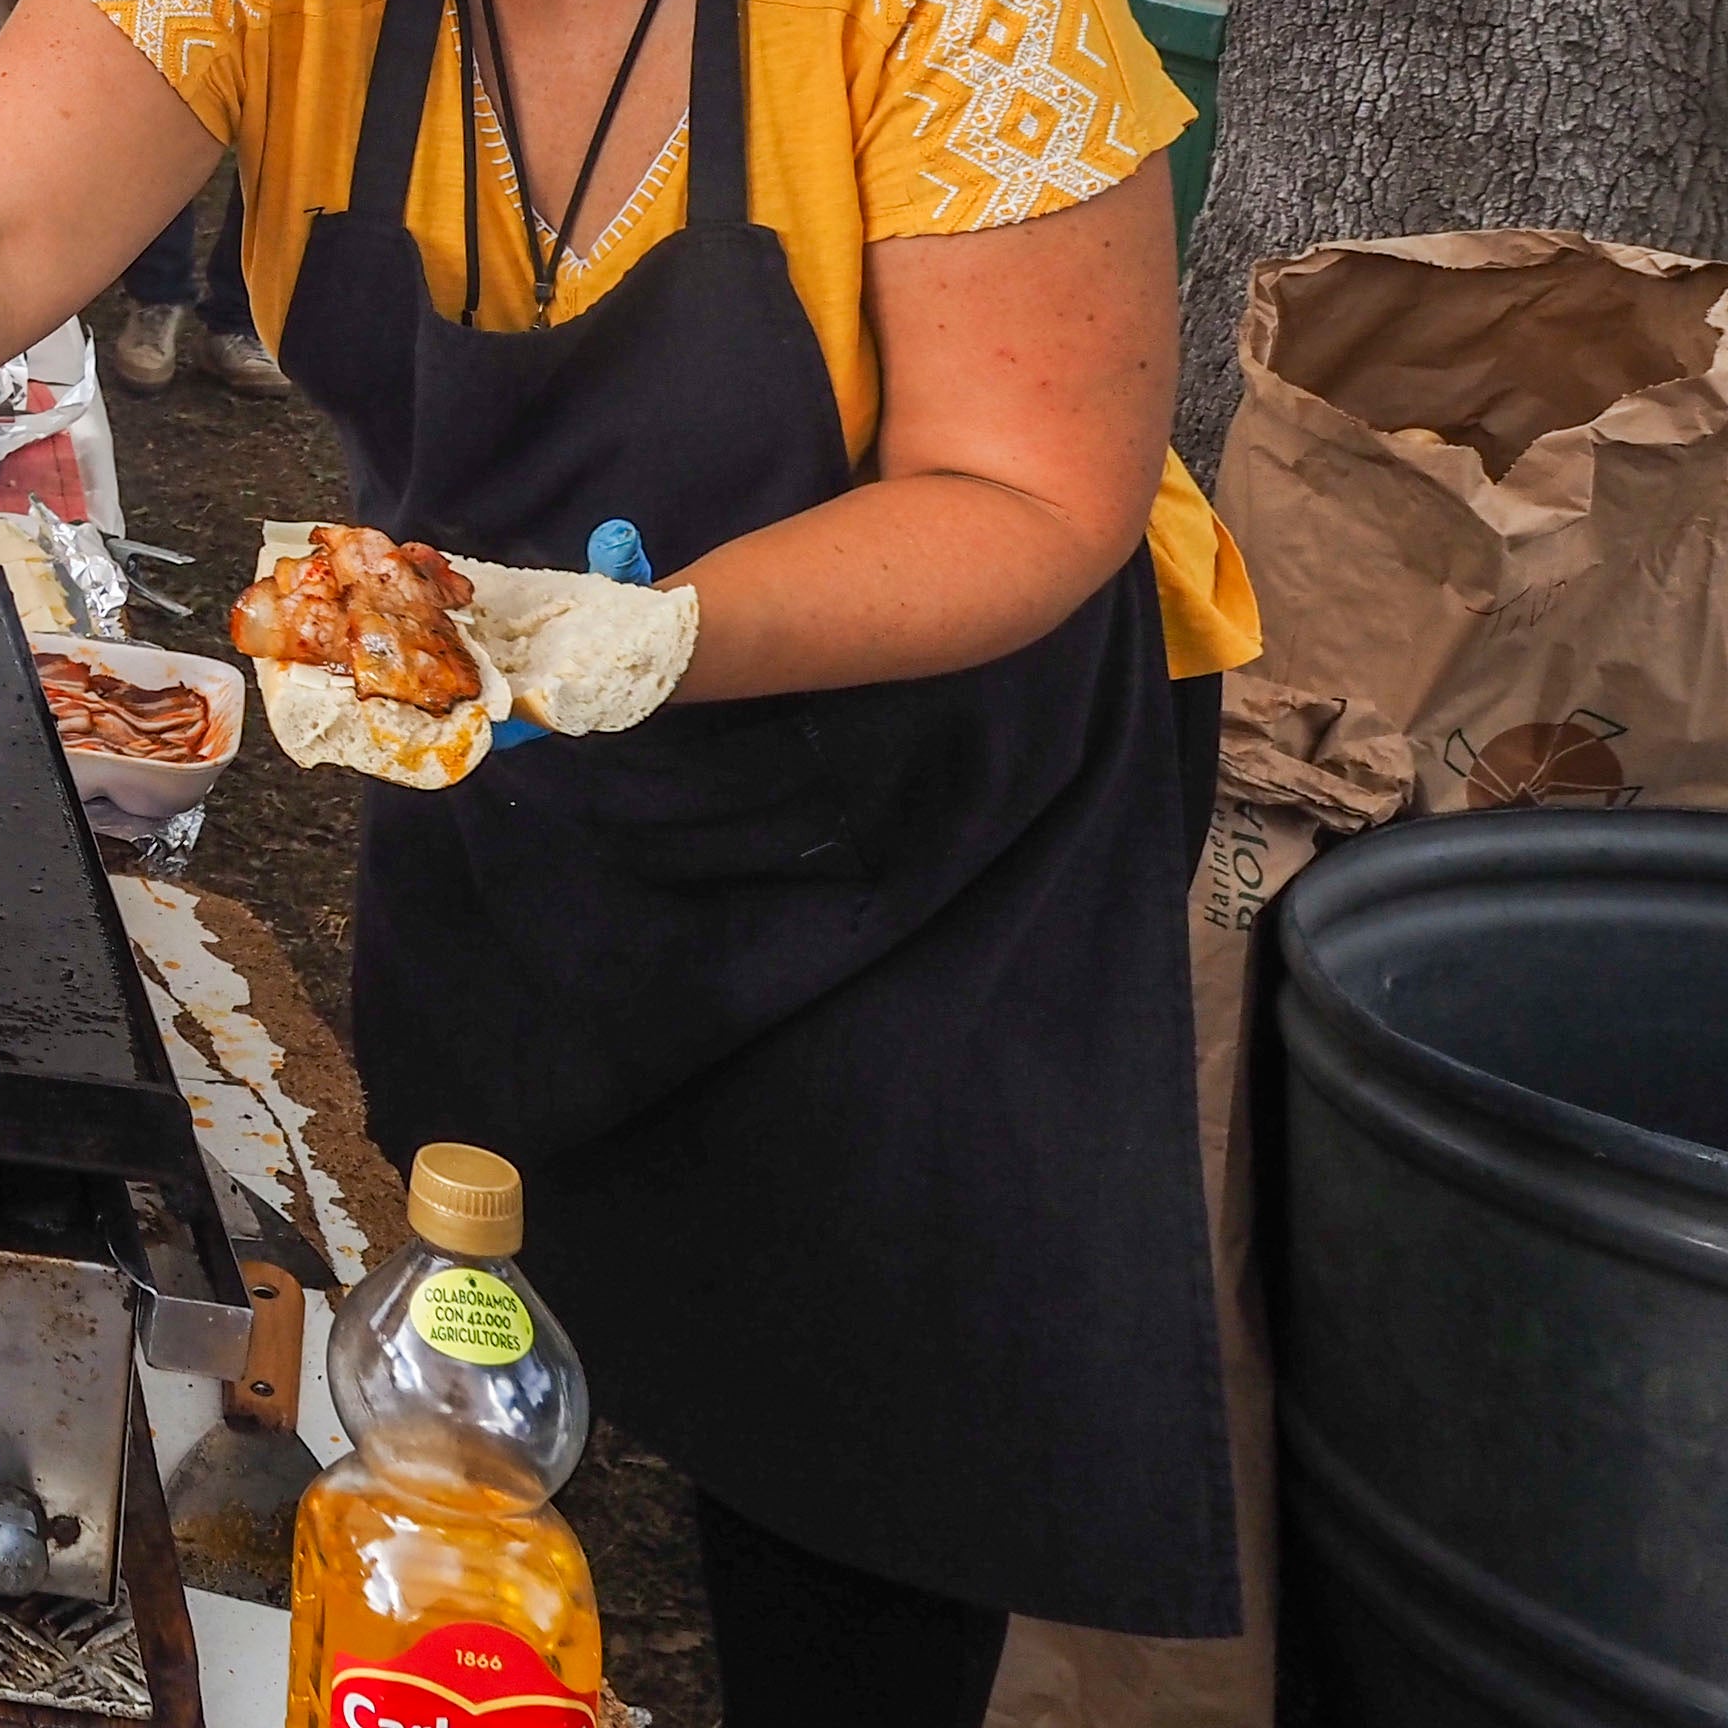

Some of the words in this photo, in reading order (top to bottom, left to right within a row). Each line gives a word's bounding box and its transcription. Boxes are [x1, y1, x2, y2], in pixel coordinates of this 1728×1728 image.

[424, 1288, 518, 1313] COLABORAMOS
[435, 1306, 463, 1322] CON
[467, 1311, 511, 1330] 42.000
[430, 1326, 521, 1351] AGRICULTORES
[455, 1649, 503, 1671] 1866
